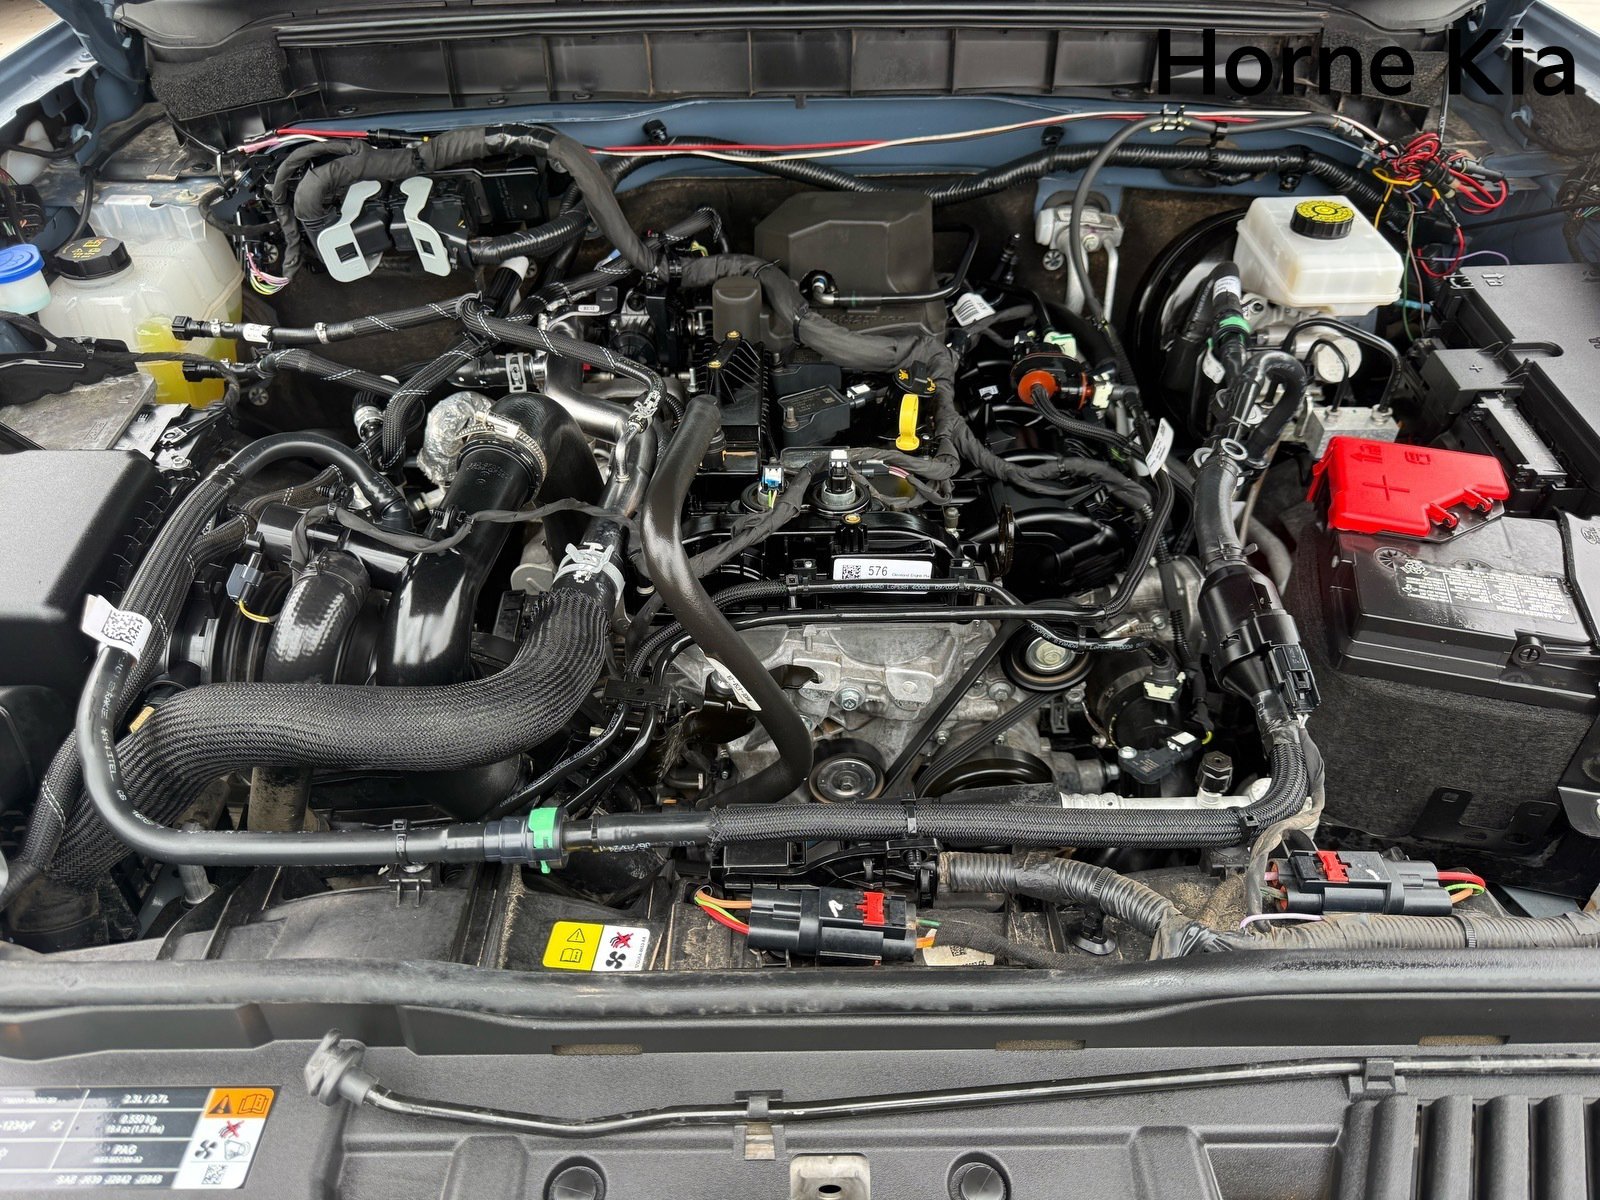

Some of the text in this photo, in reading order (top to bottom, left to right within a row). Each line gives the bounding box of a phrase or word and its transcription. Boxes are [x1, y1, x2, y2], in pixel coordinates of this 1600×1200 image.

[868, 565, 888, 576] 576
[1031, 623, 1052, 640] COOPER
[122, 1094, 143, 1104] 2.3L
[149, 1094, 170, 1104] 2.7L
[112, 1144, 138, 1155] PAG
